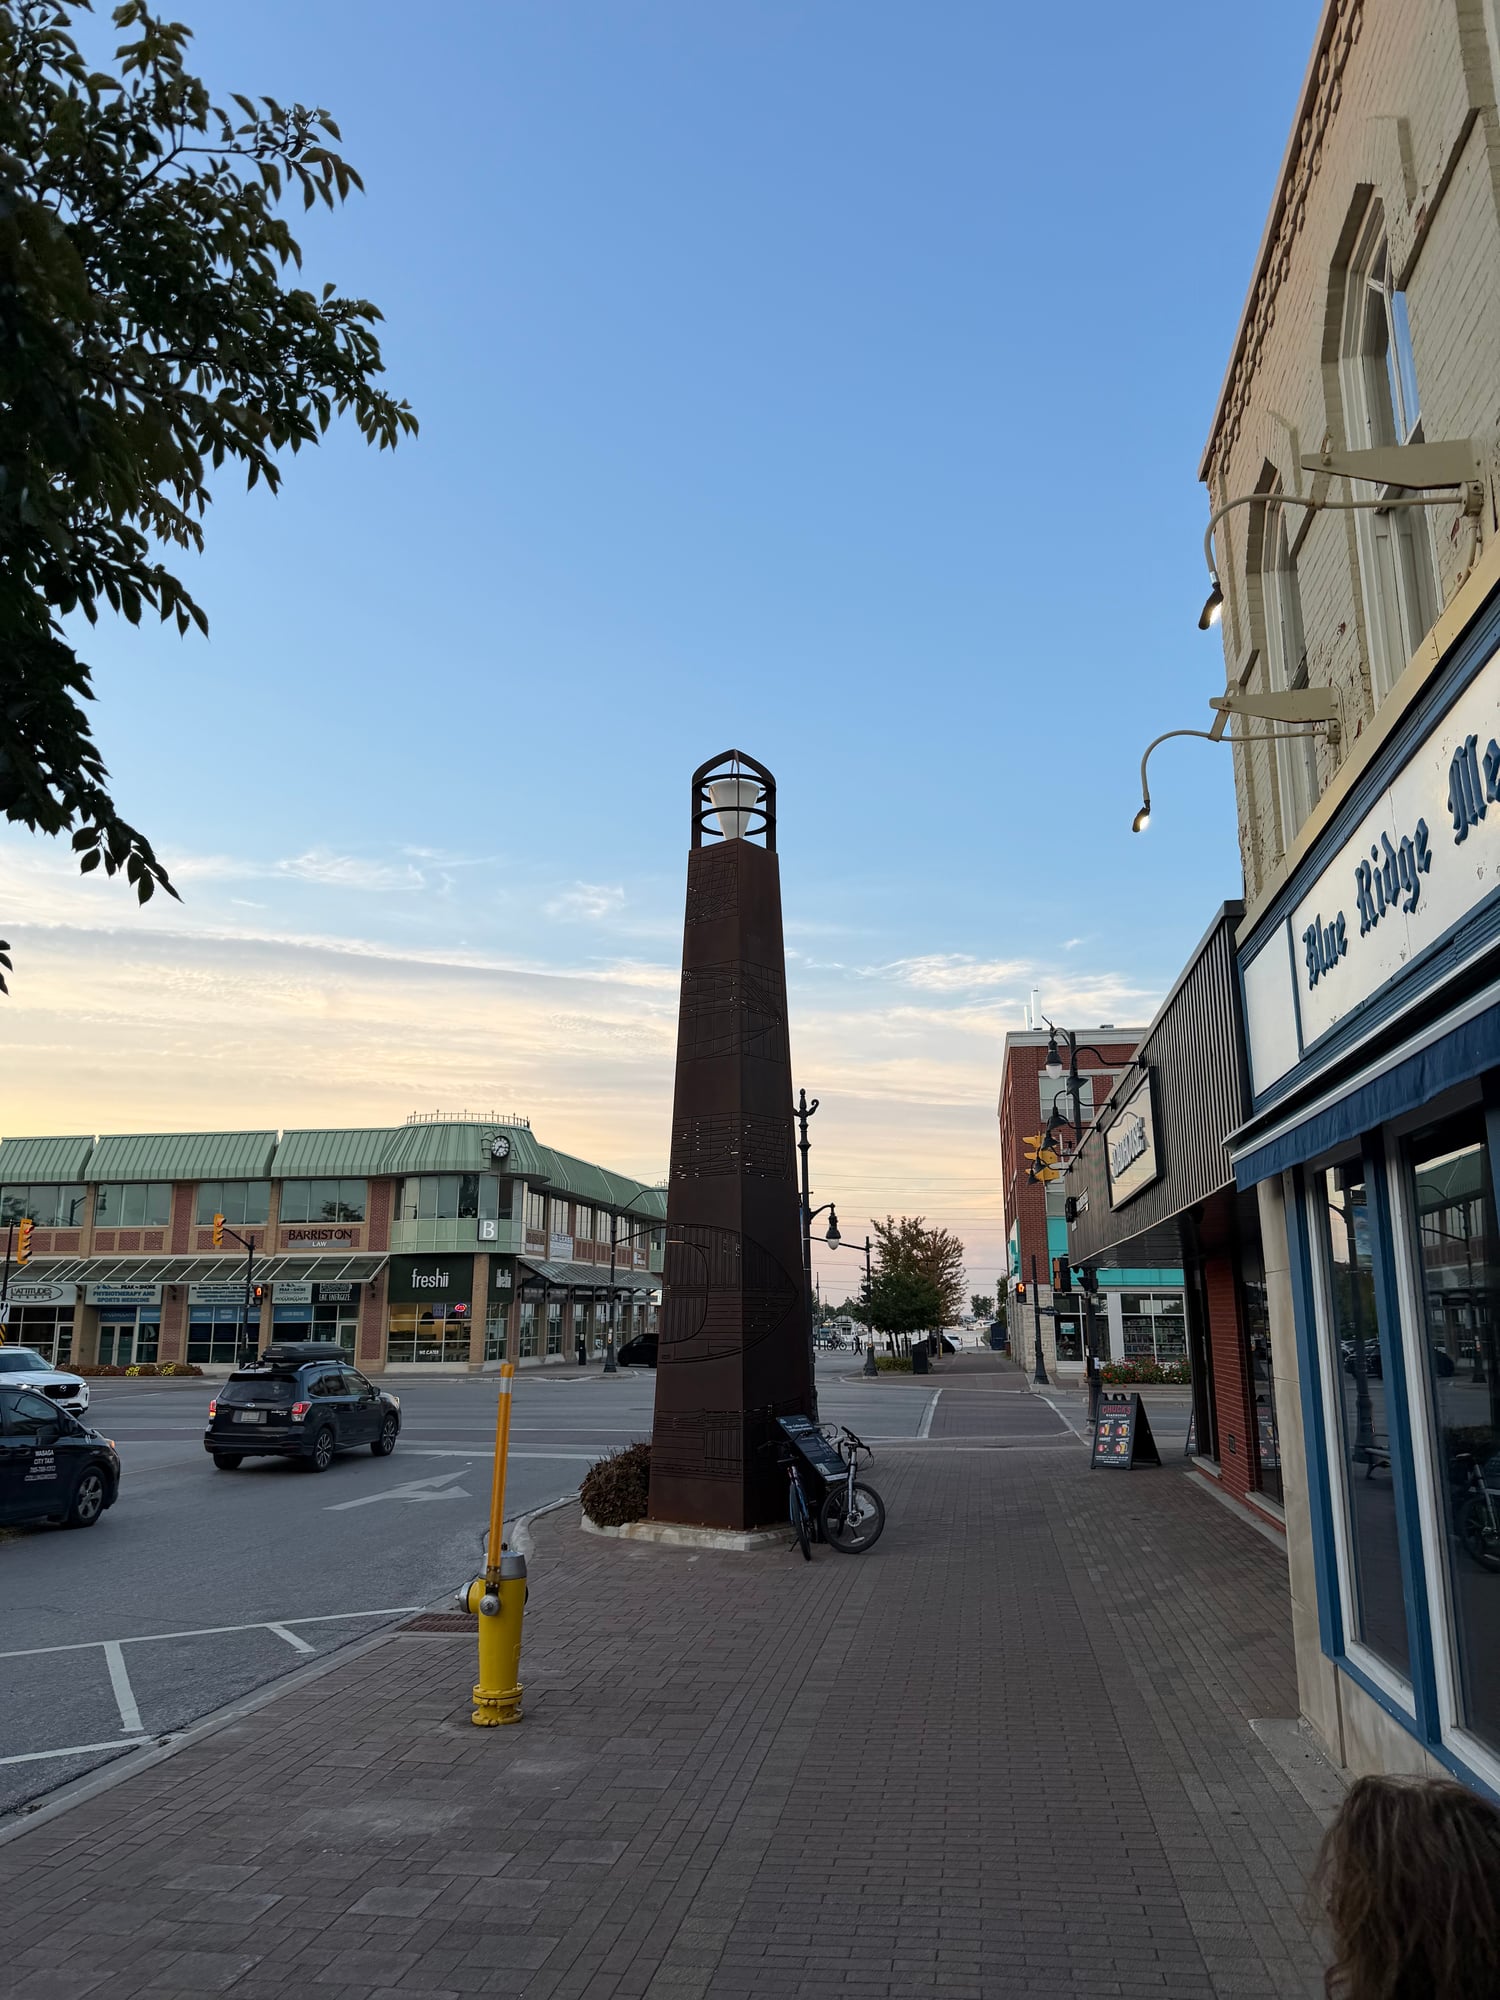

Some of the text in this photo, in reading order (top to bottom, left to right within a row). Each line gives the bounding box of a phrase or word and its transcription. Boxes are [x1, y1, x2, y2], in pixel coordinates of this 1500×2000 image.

[1302, 910, 1349, 992] Blue
[1353, 817, 1433, 939] Ridge
[288, 1229, 353, 1241] BARRISTON
[484, 1221, 495, 1239] B
[411, 1267, 449, 1288] freshii
